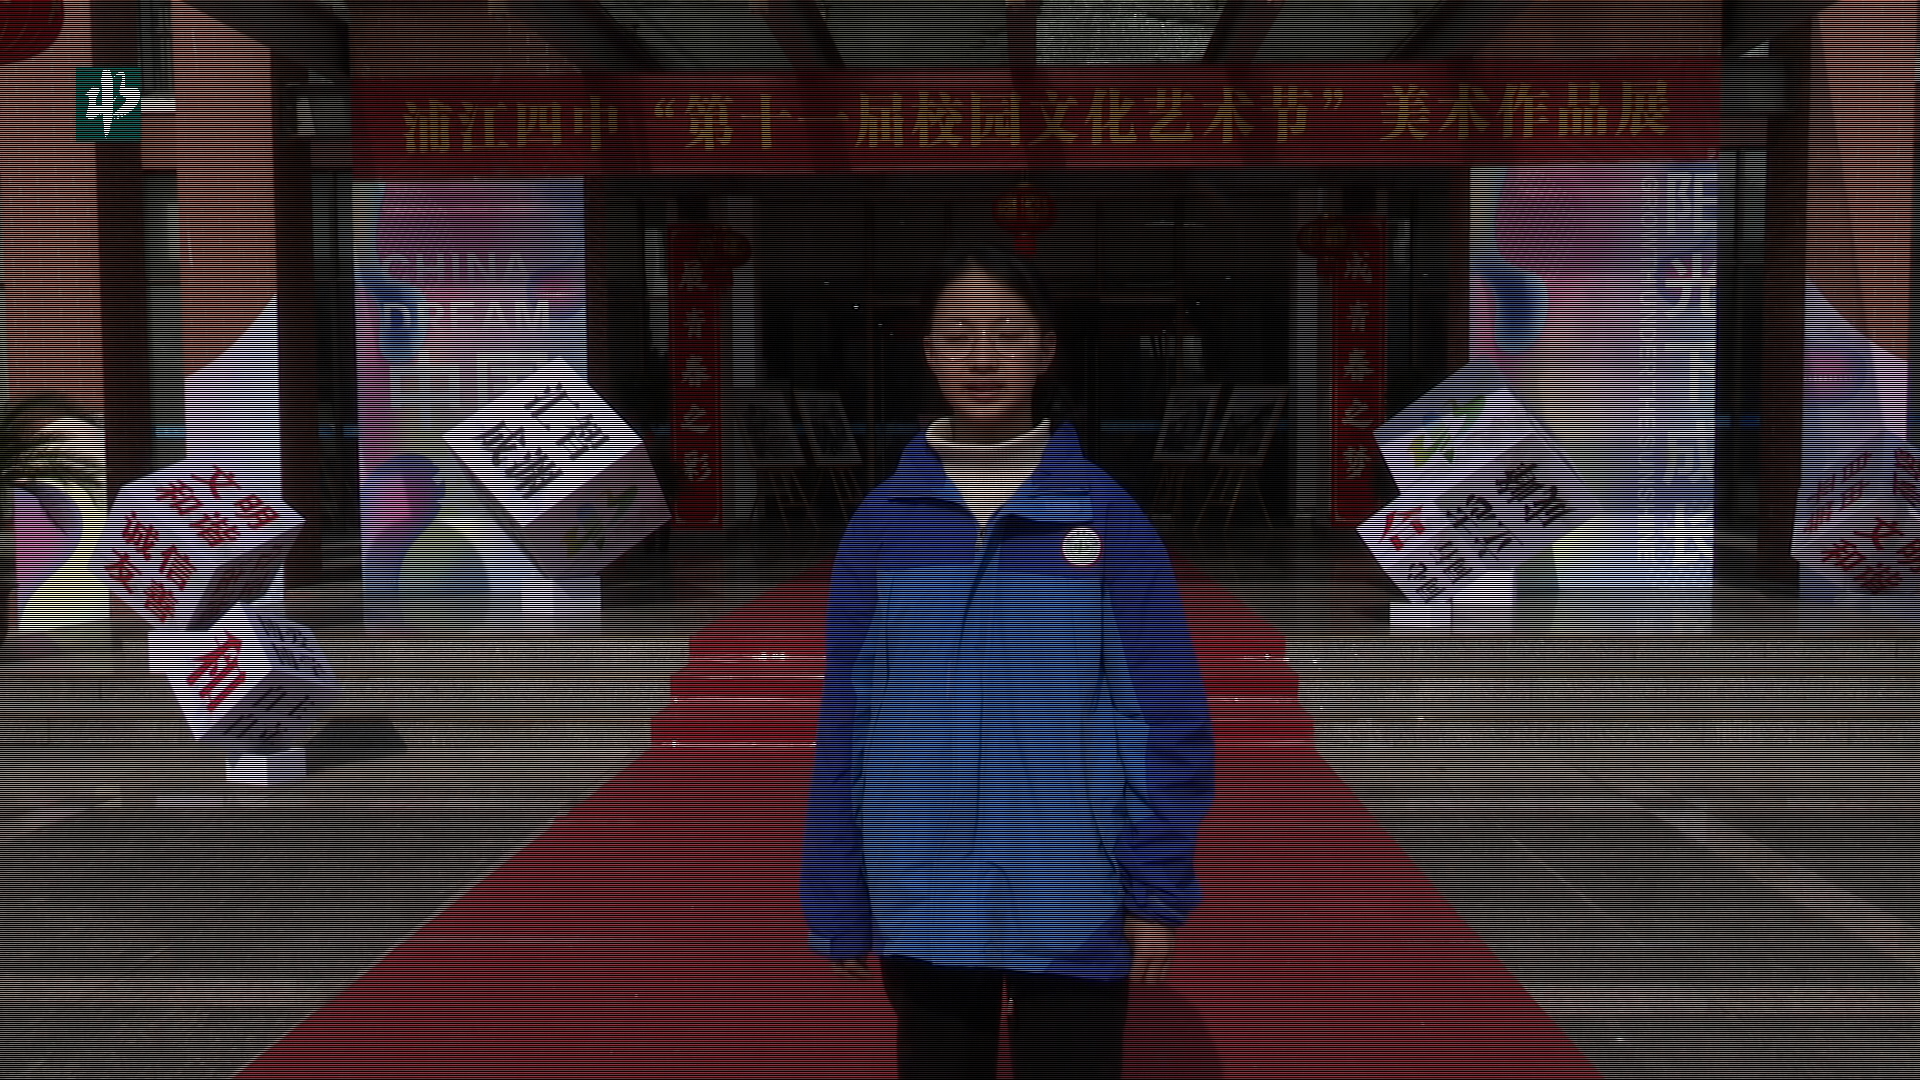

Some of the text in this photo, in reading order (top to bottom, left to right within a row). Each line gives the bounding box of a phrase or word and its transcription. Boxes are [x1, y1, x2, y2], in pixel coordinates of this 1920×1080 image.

[381, 251, 531, 285] CHINA
[383, 299, 551, 332] DREAM
[1341, 250, 1375, 480] 成青春之梦
[1637, 176, 1658, 563] GROWTH UNDER THE SUNSHINE
[523, 381, 610, 462] 汇智
[470, 419, 564, 500] 成渊
[1839, 450, 1873, 512] 自由
[155, 478, 241, 548] 和谐
[190, 464, 281, 530] 文明
[1494, 461, 1578, 529] 成峰
[121, 510, 198, 592] 诚信
[1378, 503, 1426, 552] 合
[1446, 492, 1525, 563] 立志
[104, 547, 180, 623] 友善
[1406, 560, 1446, 604] 同心
[1429, 540, 1474, 585] 同行
[1820, 538, 1903, 595] 和谐
[255, 613, 315, 653] 博爱
[270, 641, 328, 678] 博学
[186, 629, 247, 712] 和
[251, 685, 317, 720] 自主
[222, 712, 289, 747] 自立
